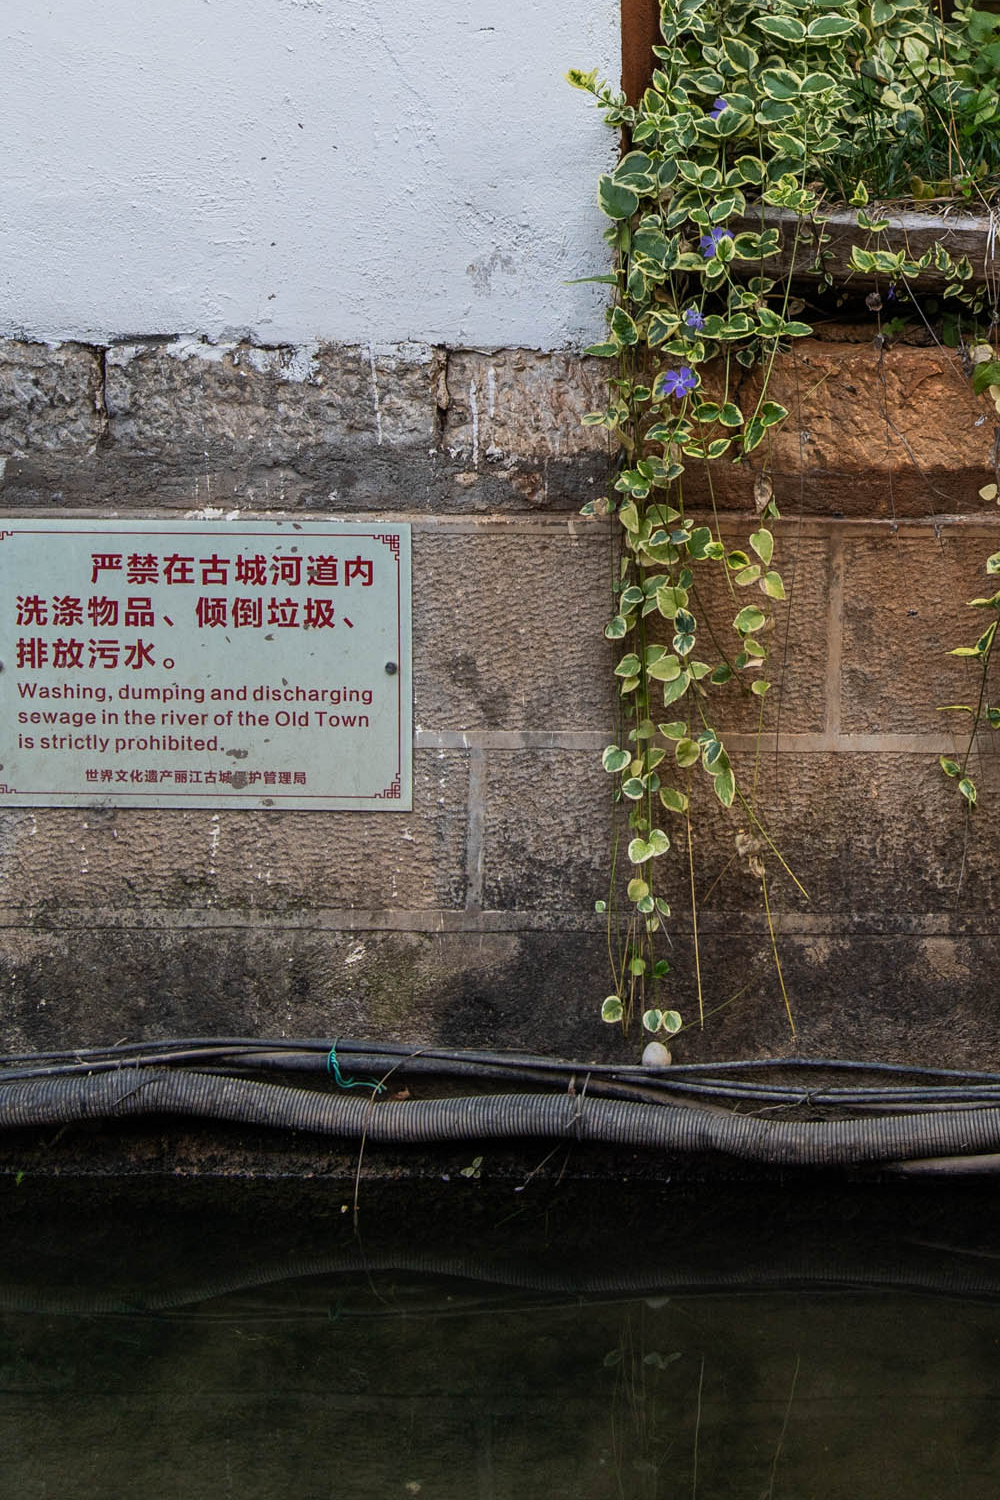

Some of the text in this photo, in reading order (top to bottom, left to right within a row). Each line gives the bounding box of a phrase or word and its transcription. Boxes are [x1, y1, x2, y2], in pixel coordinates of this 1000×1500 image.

[90, 553, 374, 587] 严禁在古城河道内
[15, 596, 355, 628] 洗涤物品、倾倒垃圾、
[15, 637, 176, 669] 排放污水。
[17, 683, 373, 706] Washing, dumping and discharging
[17, 709, 369, 727] sewage in the river of the Old Town
[18, 734, 225, 753] is strictly prohibited.
